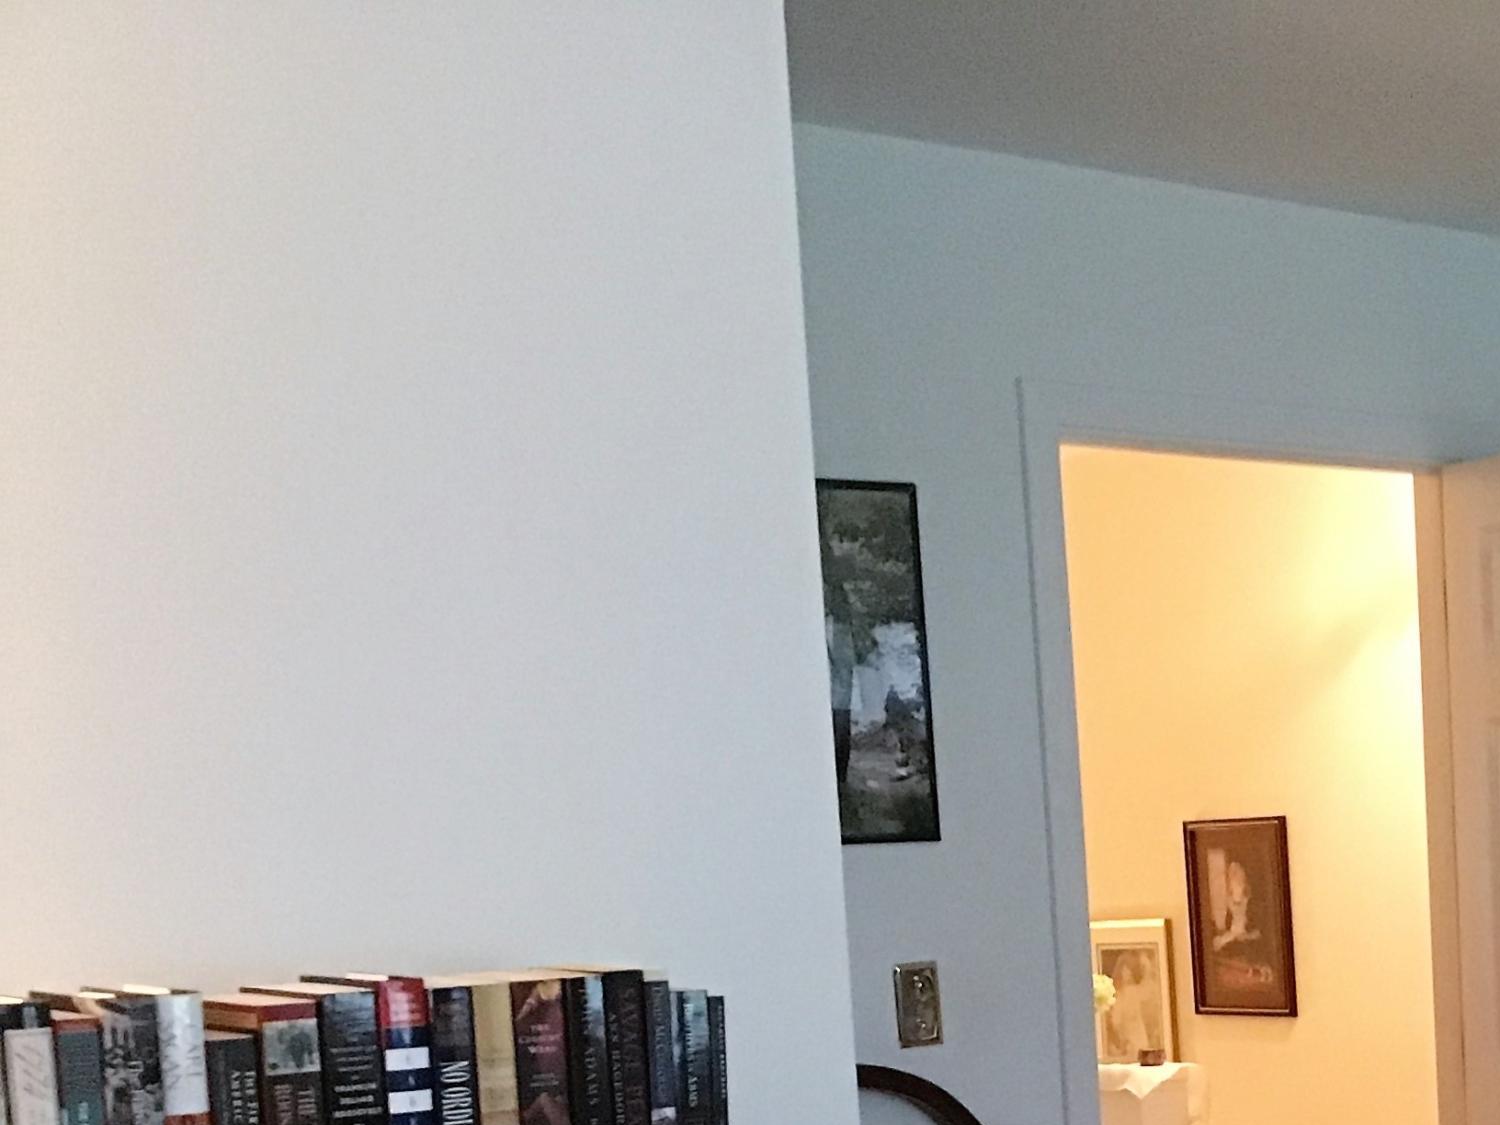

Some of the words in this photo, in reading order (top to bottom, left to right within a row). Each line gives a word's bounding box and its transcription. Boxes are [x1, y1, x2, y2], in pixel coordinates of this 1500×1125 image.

[440, 1061, 470, 1083] NO
[583, 1047, 599, 1105] ADAMS
[297, 1088, 315, 1118] THE
